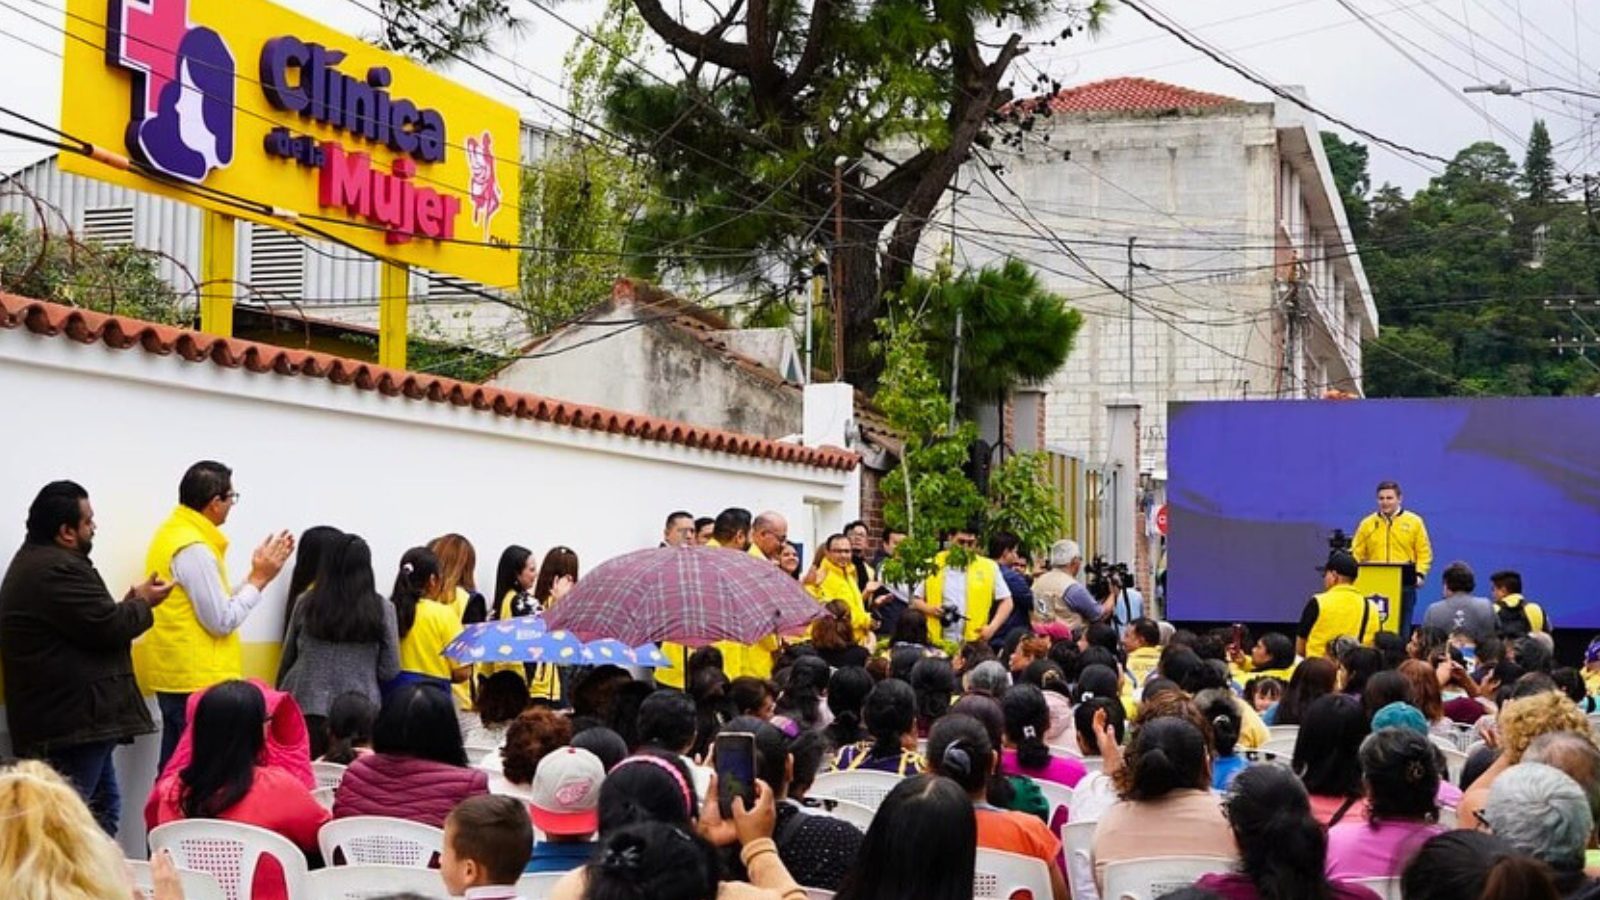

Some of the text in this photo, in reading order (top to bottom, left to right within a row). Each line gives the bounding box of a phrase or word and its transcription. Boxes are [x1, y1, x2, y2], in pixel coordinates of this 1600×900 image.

[259, 35, 446, 164] Clínica
[263, 126, 304, 161] de
[319, 141, 461, 245] Mujer
